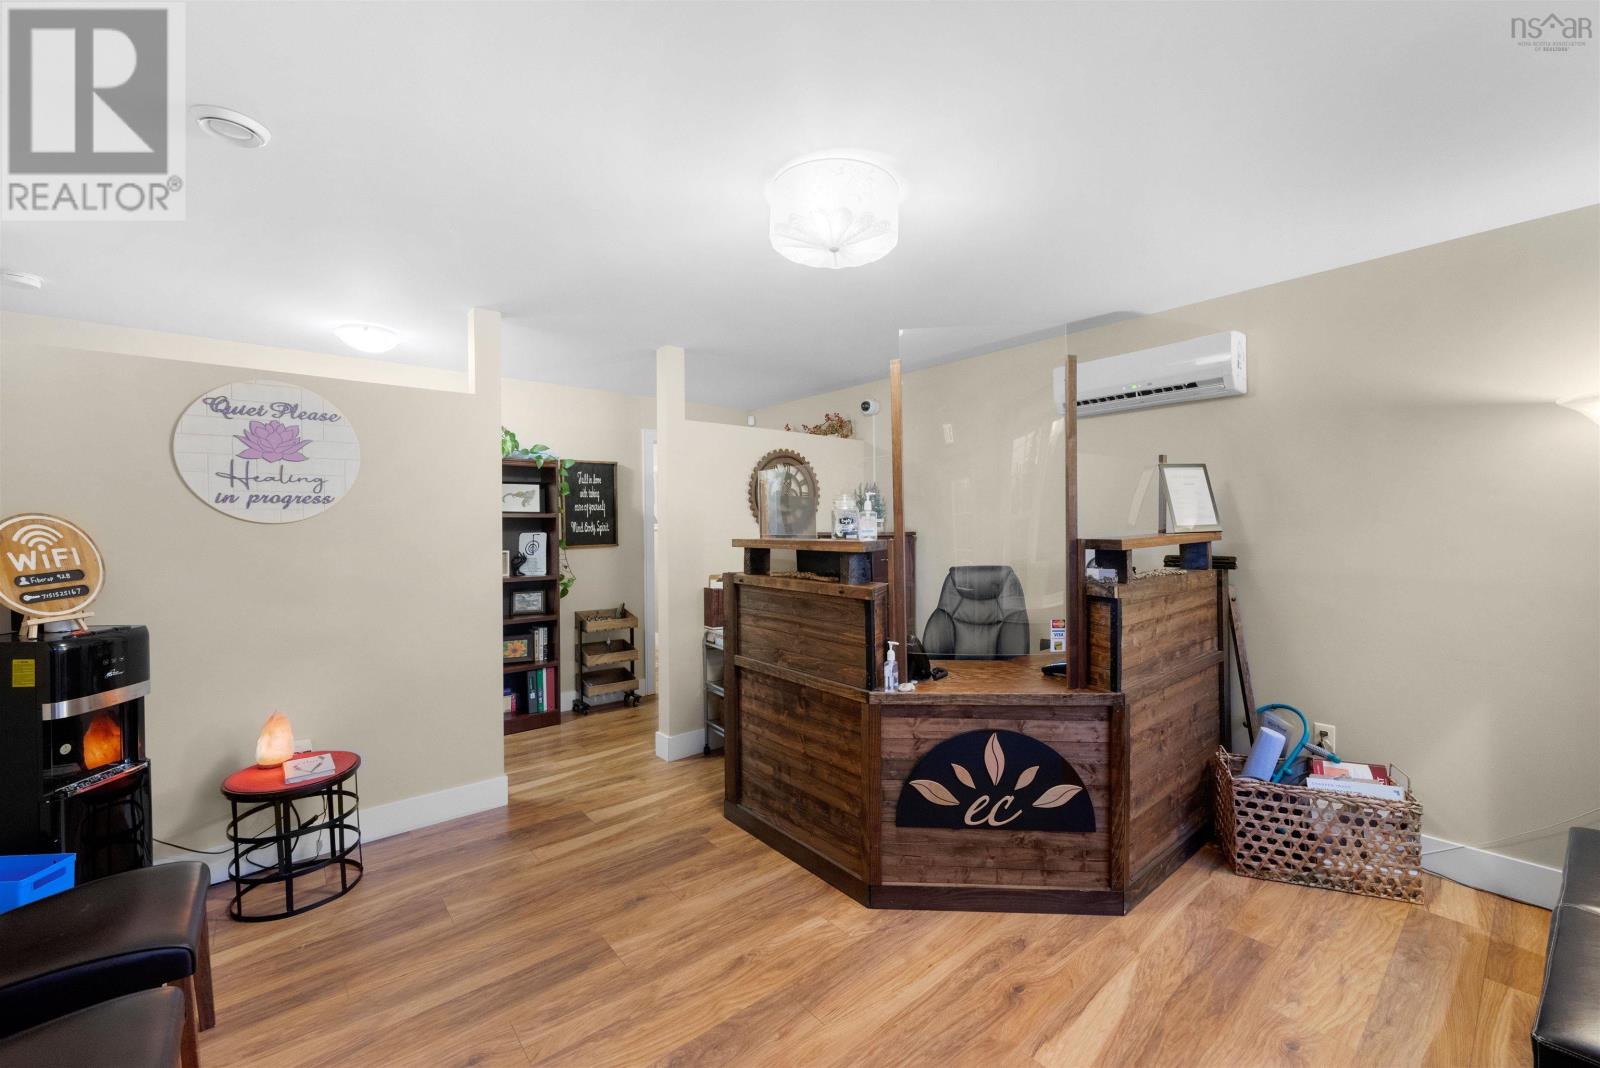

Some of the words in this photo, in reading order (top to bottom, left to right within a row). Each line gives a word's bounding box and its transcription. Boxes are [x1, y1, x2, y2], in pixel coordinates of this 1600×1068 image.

[203, 396, 267, 420] Quiet
[270, 402, 341, 422] Please
[215, 459, 328, 494] Healing
[215, 492, 240, 504] in
[246, 493, 335, 510] progress
[964, 794, 1023, 827] ec
